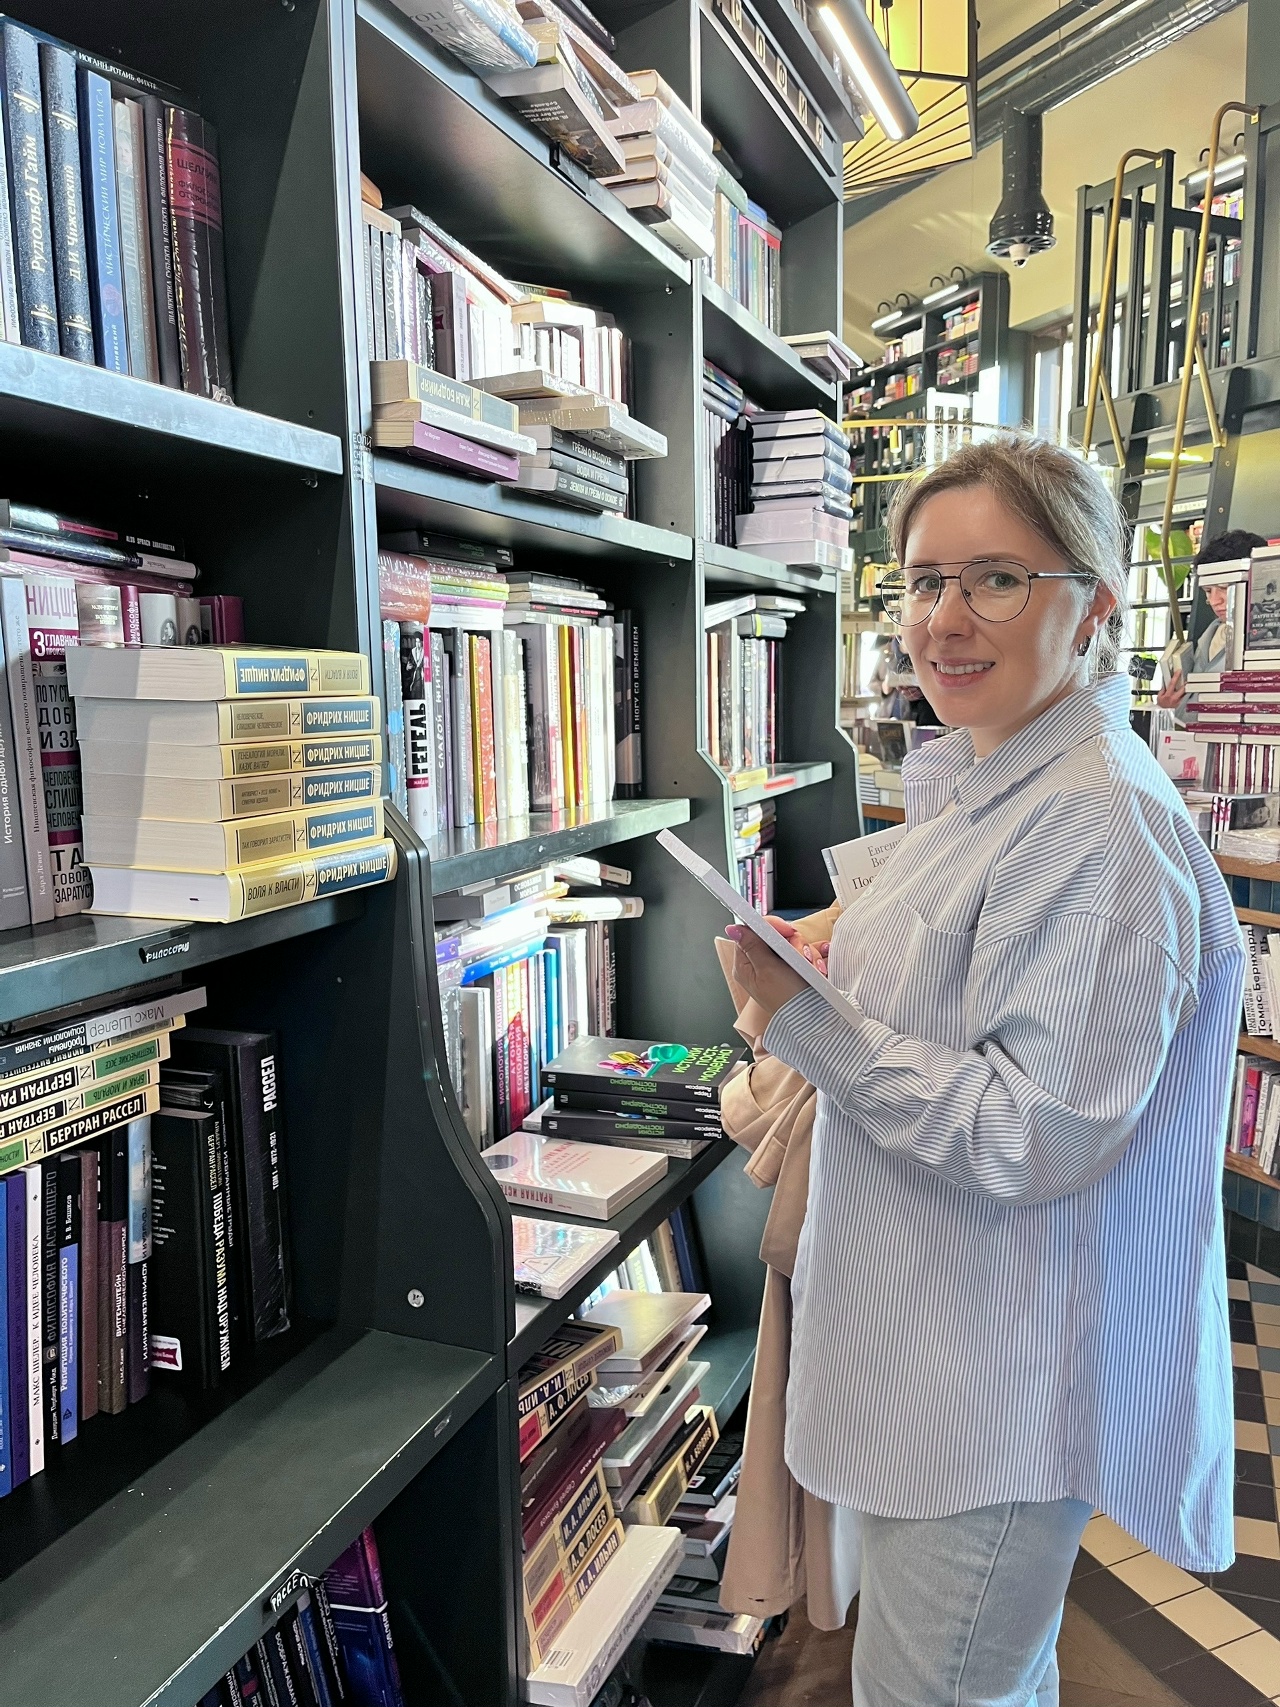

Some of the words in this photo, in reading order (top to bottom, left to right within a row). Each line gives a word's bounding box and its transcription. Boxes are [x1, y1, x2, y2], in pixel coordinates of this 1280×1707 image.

[95, 88, 106, 155] НОВАЛИСА
[23, 135, 40, 185] Гайм
[97, 157, 108, 183] МИР
[158, 155, 167, 197] ФИЛОСОФИИ
[64, 165, 78, 247] Чижевский
[25, 188, 47, 273] Рудольф
[99, 187, 114, 277] МИСТИЧЕСКИЙ
[68, 251, 79, 265] И.
[164, 246, 172, 280] СУБЪЕКТА
[70, 267, 81, 281] Д.
[166, 281, 176, 325] ДИАЛЕКТИКА
[420, 377, 455, 402] БОДРИЙЯР
[455, 390, 470, 408] ЖАН
[33, 631, 46, 657] 3
[45, 633, 78, 647] ГЛАВНЫХ
[18, 649, 28, 701] возвращения
[240, 667, 269, 684] НИЦШЕ
[271, 666, 305, 682] ФРИДРИХ
[633, 683, 640, 693] СО
[36, 684, 47, 704] ПО
[48, 684, 58, 702] ТУ
[24, 702, 33, 736] вечного
[38, 707, 72, 727] ДОБ
[306, 710, 342, 725] ФРИДРИХ
[343, 708, 369, 723] НИЦШЕ
[41, 731, 54, 749] И
[307, 746, 343, 761] ФРИДРИХ
[343, 744, 369, 758] НИЦШЕ
[410, 702, 428, 776] ГЕГЕЛЬ
[436, 714, 445, 769] СЛАВОЙ
[26, 736, 38, 782] философия
[0, 760, 9, 794] одной
[307, 782, 344, 797] ФРИДРИХ
[344, 778, 369, 793] НИЦШЕ
[3, 796, 13, 844] История
[310, 821, 346, 839] ФРИДРИХ
[346, 815, 373, 832] НИЦШЕ
[250, 836, 268, 848] ГОВОРИЛ
[867, 836, 900, 857] Евгени
[319, 865, 358, 884] ФРИДРИХ
[359, 855, 387, 874] НИЦШЕ
[38, 876, 46, 896] Карл
[247, 882, 266, 901] ВОЛЯ
[267, 881, 274, 895] К
[275, 876, 300, 894] ВЛАСТИ
[1246, 928, 1262, 990] Бернхард
[89, 1012, 132, 1038] Шелер
[135, 1005, 164, 1025] Макс
[1255, 996, 1266, 1034] Томас
[15, 1038, 42, 1054] знания
[43, 1025, 85, 1048] социологии
[49, 1036, 85, 1054] Проблемы
[104, 1058, 121, 1070] ЭССЕ
[496, 1039, 505, 1104] МИФОЛОГИЯ
[515, 1026, 523, 1093] ТОПОЛОГИЯ
[17, 1070, 73, 1102] БЕРТРАН
[93, 1080, 120, 1101] МОРАЛЬ
[122, 1079, 128, 1090] И
[129, 1073, 145, 1088] БРАК
[261, 1055, 278, 1113] РАССЕЛ
[9, 1105, 57, 1134] БЕРТРАН
[50, 1117, 100, 1147] БЕРТРАН
[103, 1098, 141, 1127] РАССЕЛ
[207, 1134, 216, 1164] БЕРТРАН
[703, 1131, 722, 1139] Перри
[208, 1164, 217, 1191] РАССЕЛ
[46, 1171, 57, 1258] НАСТОЯЩЕГО
[212, 1192, 226, 1240] ПОБЕДА
[214, 1241, 227, 1289] РАЗУМА
[47, 1263, 57, 1342] ФИЛОСОФИЯ
[60, 1257, 69, 1334] политического
[216, 1286, 229, 1315] НАД
[32, 1320, 39, 1329] К
[218, 1315, 231, 1371] ОРУЖИЕМ
[60, 1337, 69, 1392] Репетиция
[537, 1383, 550, 1397] А.
[549, 1375, 563, 1390] И.
[578, 1480, 600, 1518] ИЛЬИН
[586, 1509, 608, 1547] ЛОСЕВ
[578, 1577, 588, 1596] И.
[587, 1567, 597, 1584] А.
[595, 1533, 619, 1572] ИЛЬИН
